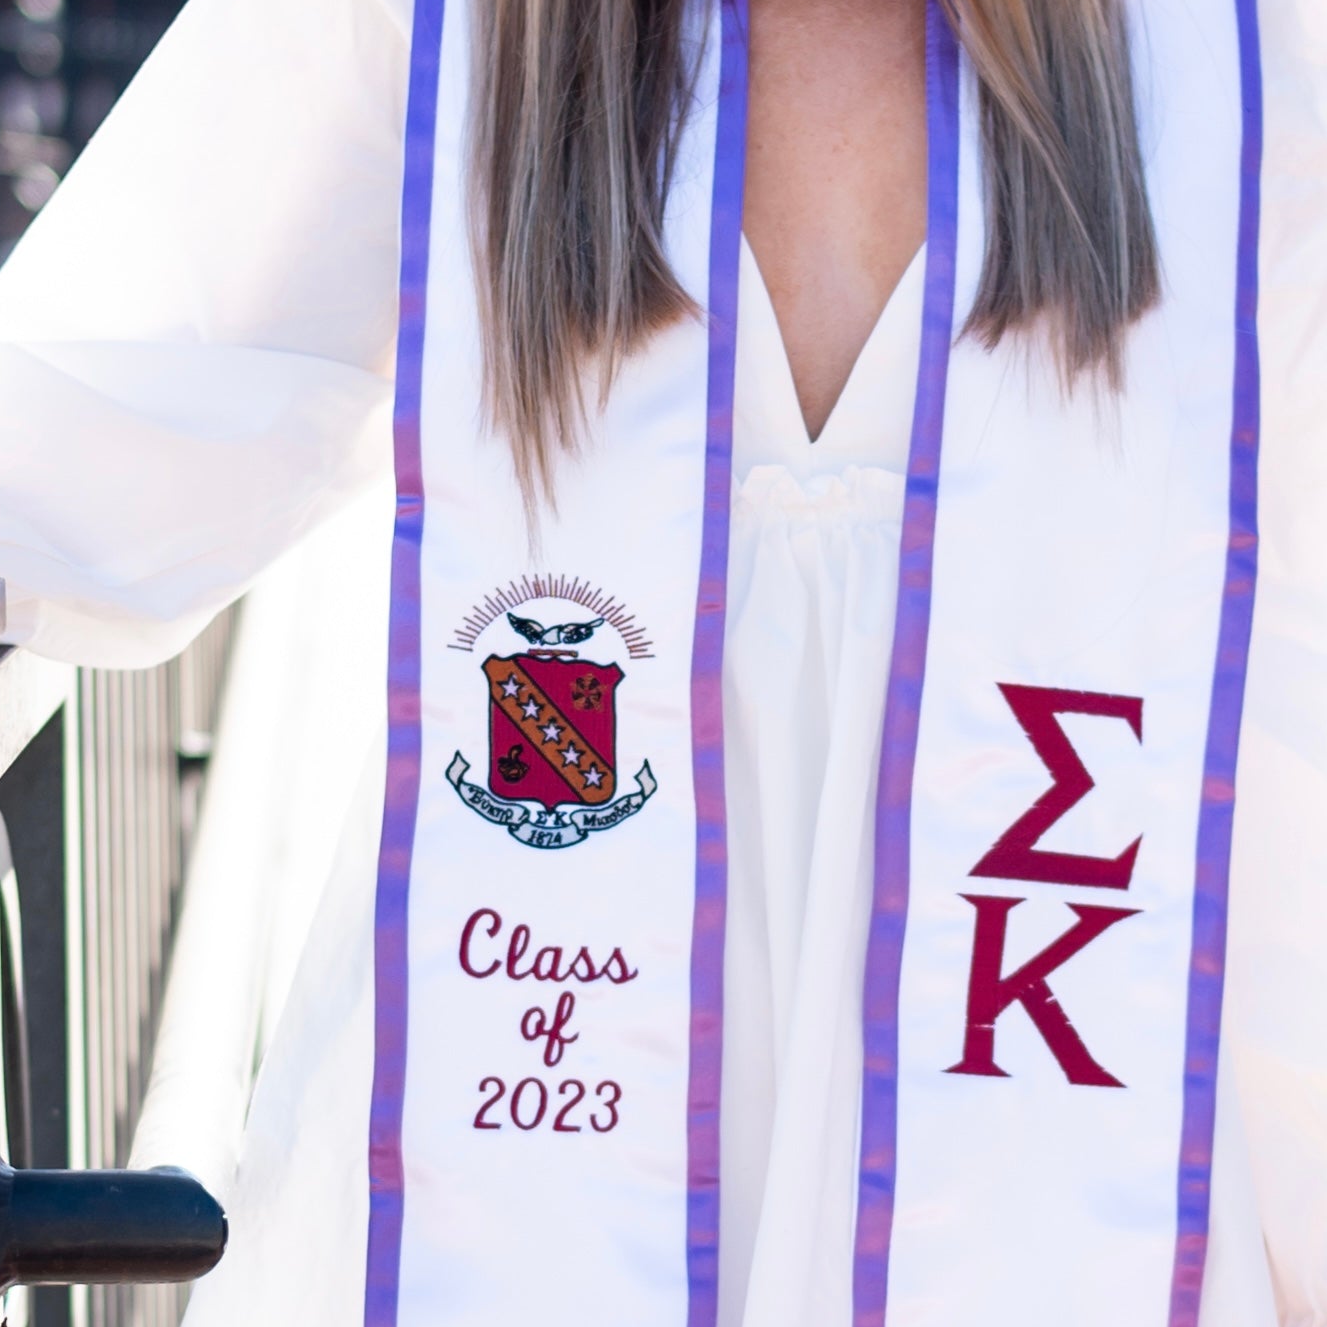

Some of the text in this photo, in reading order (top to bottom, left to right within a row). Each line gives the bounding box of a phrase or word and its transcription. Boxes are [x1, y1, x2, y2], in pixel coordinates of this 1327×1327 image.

[967, 682, 1144, 890] Σ
[528, 829, 562, 846] 1874
[458, 908, 639, 984] Class
[520, 991, 579, 1068] of
[472, 1076, 623, 1133] 2023
